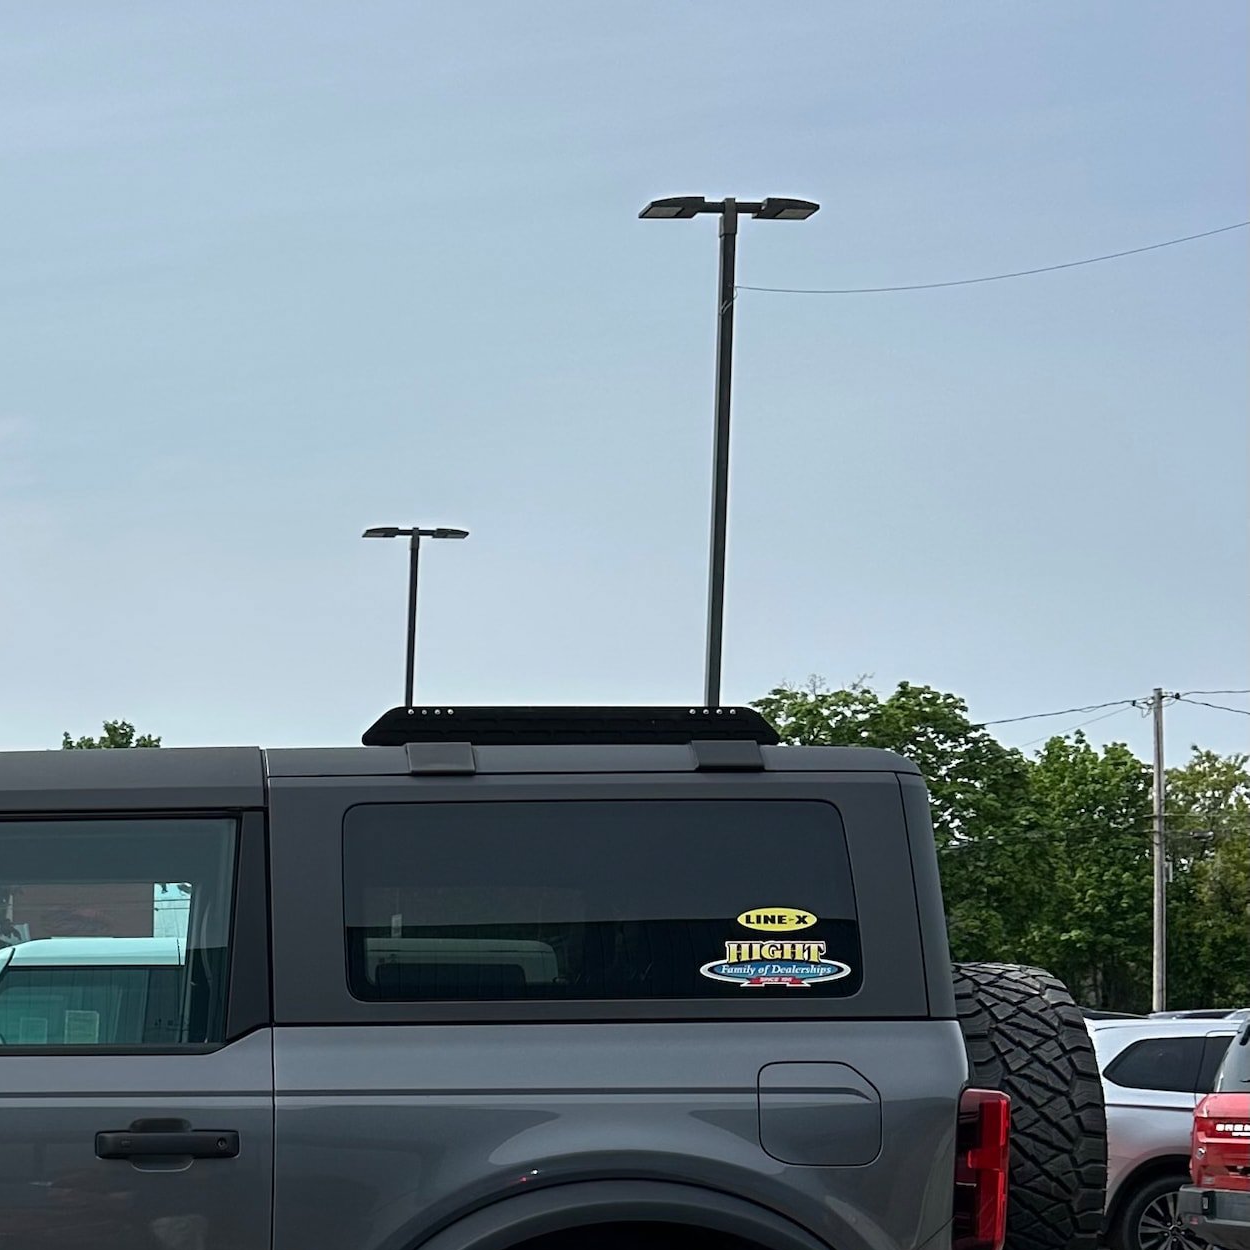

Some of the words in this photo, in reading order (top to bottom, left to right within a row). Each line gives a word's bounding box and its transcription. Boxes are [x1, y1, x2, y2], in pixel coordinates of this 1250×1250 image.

[745, 914, 809, 925] LINE-X
[726, 942, 825, 964] HIGHT
[721, 964, 756, 975] Family
[758, 964, 770, 975] of
[772, 964, 832, 976] Dealerships
